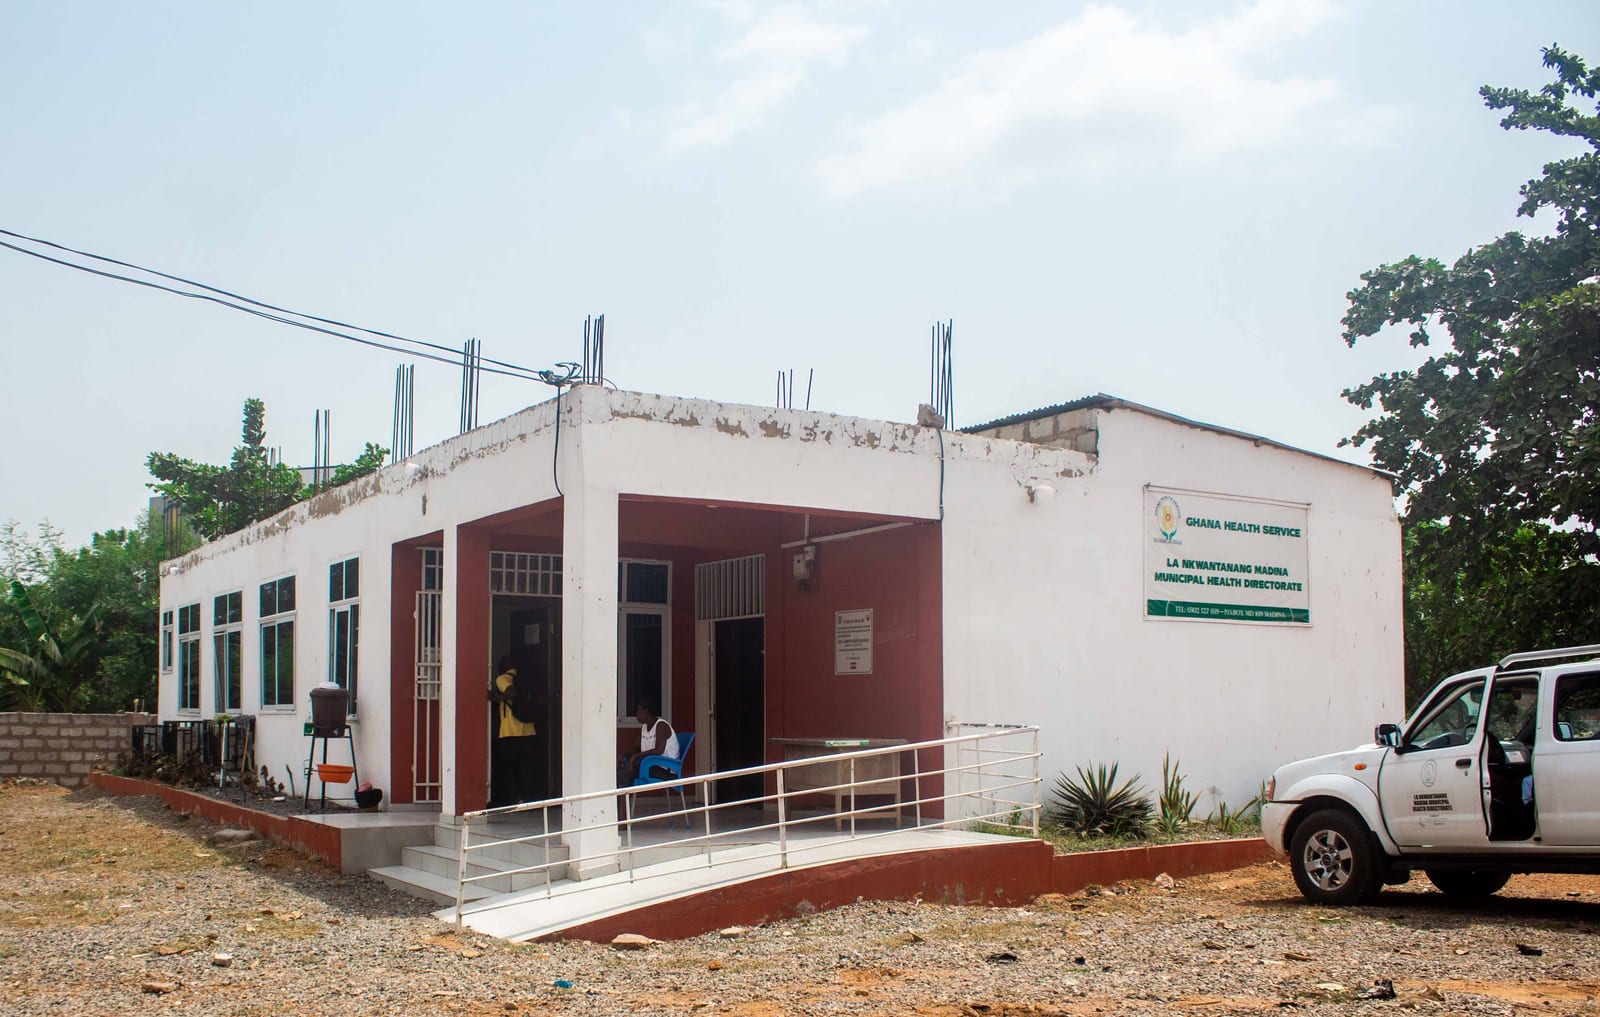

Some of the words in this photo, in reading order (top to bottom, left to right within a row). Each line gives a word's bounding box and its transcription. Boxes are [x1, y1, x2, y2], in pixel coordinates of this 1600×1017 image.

[1186, 516, 1221, 530] GHANA
[1224, 520, 1260, 534] HEALTH
[1262, 525, 1302, 538] SERVICE
[1167, 558, 1179, 568] LA
[1182, 559, 1252, 574] NKWANTANANG
[1254, 565, 1289, 577] MADINA
[1154, 572, 1205, 585] MUNICIPAL
[1207, 576, 1242, 588] HEALTH
[1244, 578, 1303, 592] DIRECTORATE
